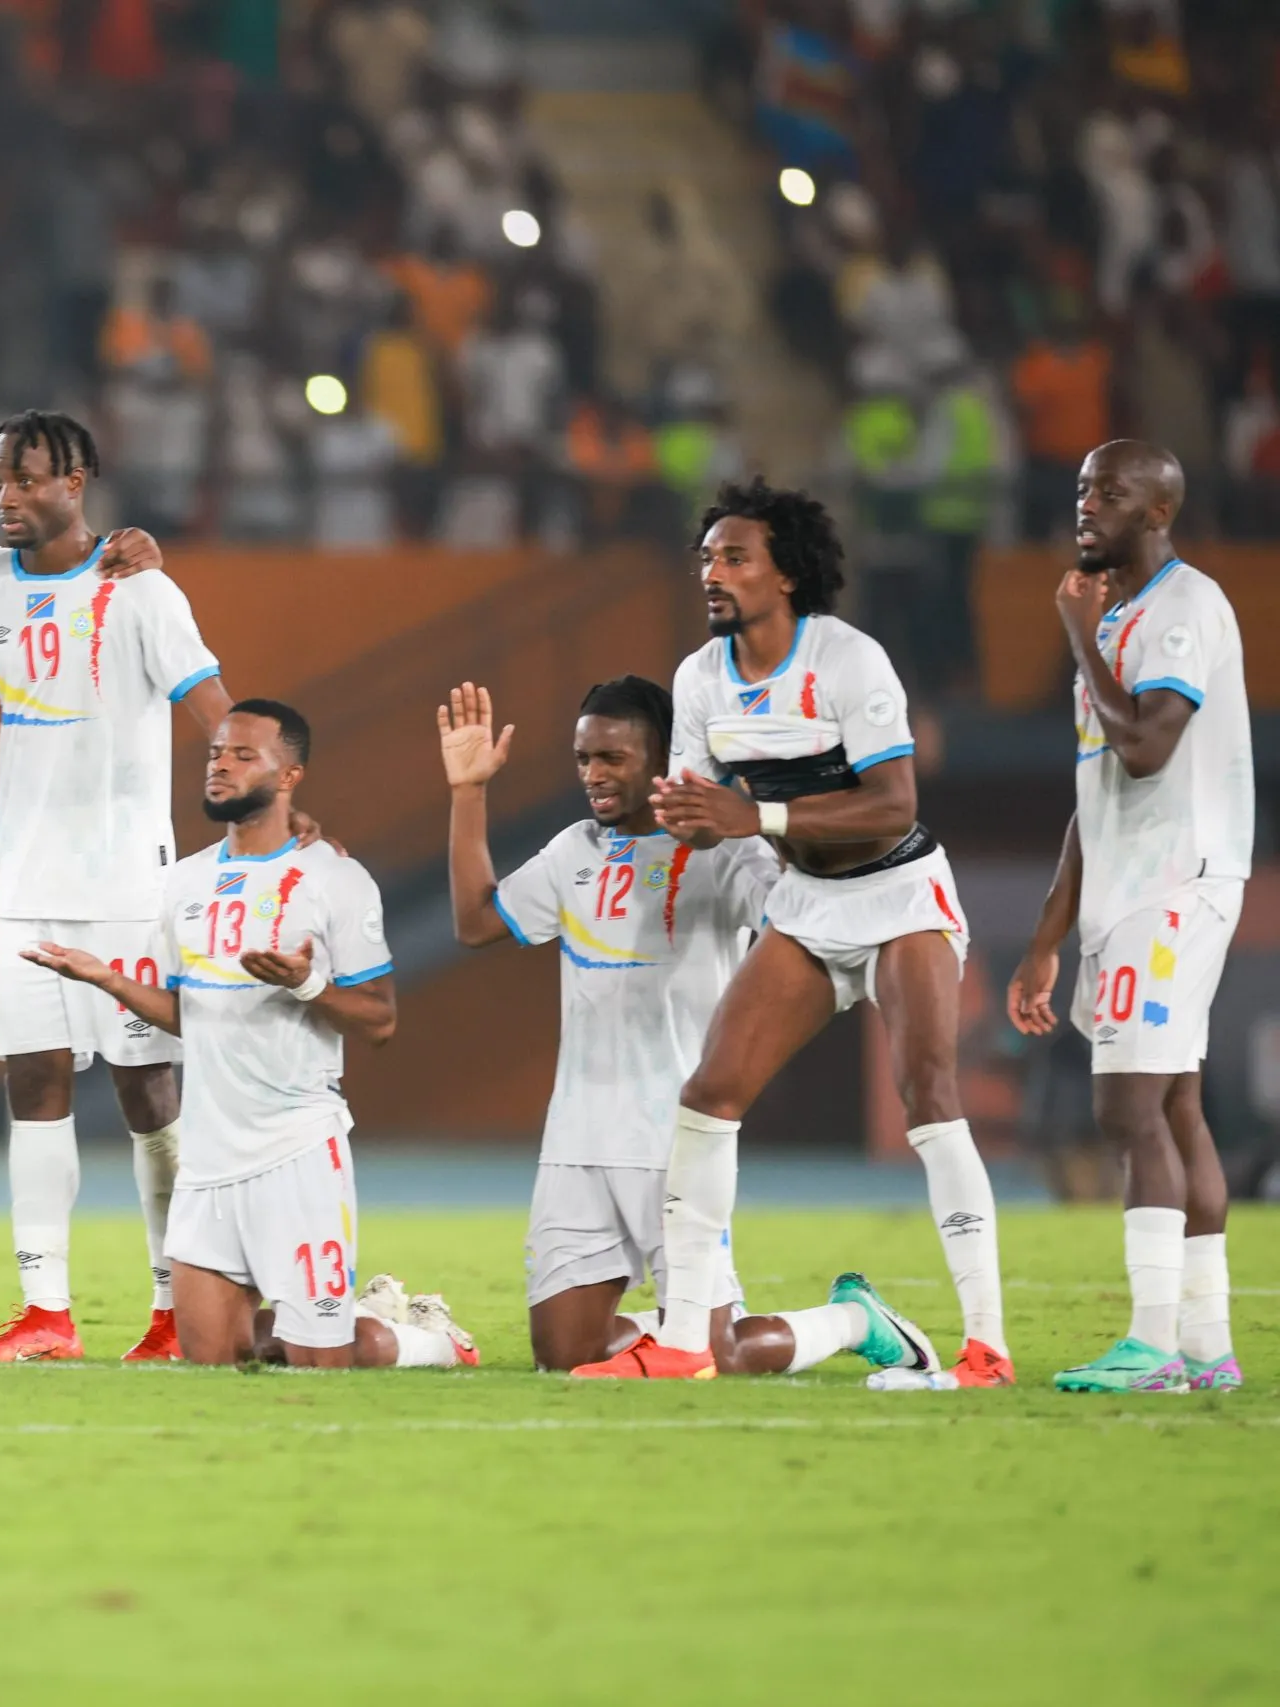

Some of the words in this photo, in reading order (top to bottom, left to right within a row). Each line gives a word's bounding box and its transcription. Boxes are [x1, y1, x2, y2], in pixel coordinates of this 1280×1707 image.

[18, 622, 60, 682] 19
[595, 864, 635, 921] 12
[205, 900, 246, 958] 13
[294, 1240, 347, 1301] 13
